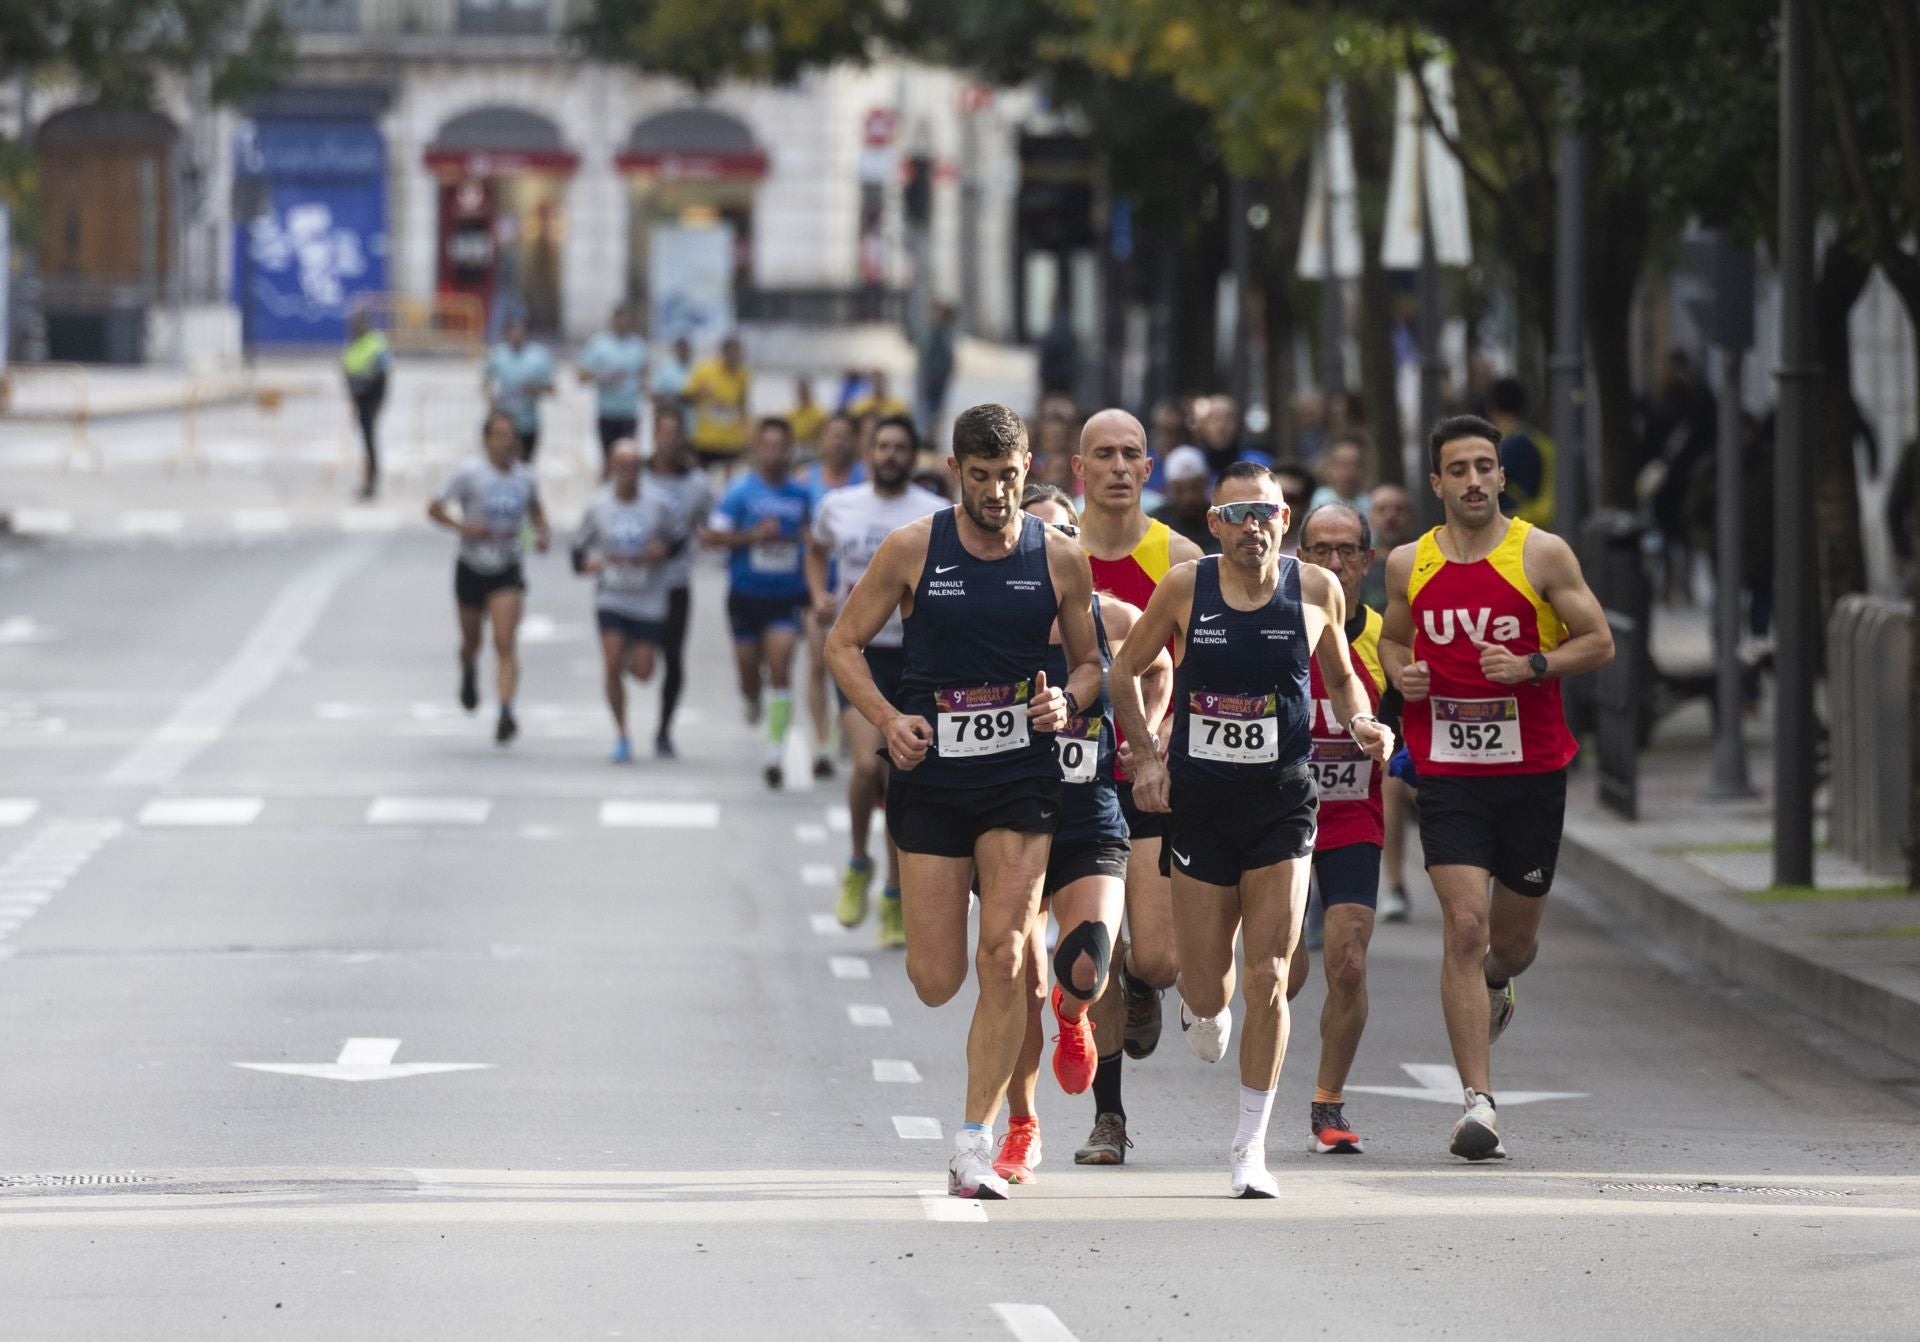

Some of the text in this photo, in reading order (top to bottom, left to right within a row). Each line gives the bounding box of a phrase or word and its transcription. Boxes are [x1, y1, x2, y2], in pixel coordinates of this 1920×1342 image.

[1423, 607, 1521, 645] UVa
[951, 710, 1015, 743] 789
[1202, 718, 1265, 750] 788
[1448, 723, 1503, 751] 952
